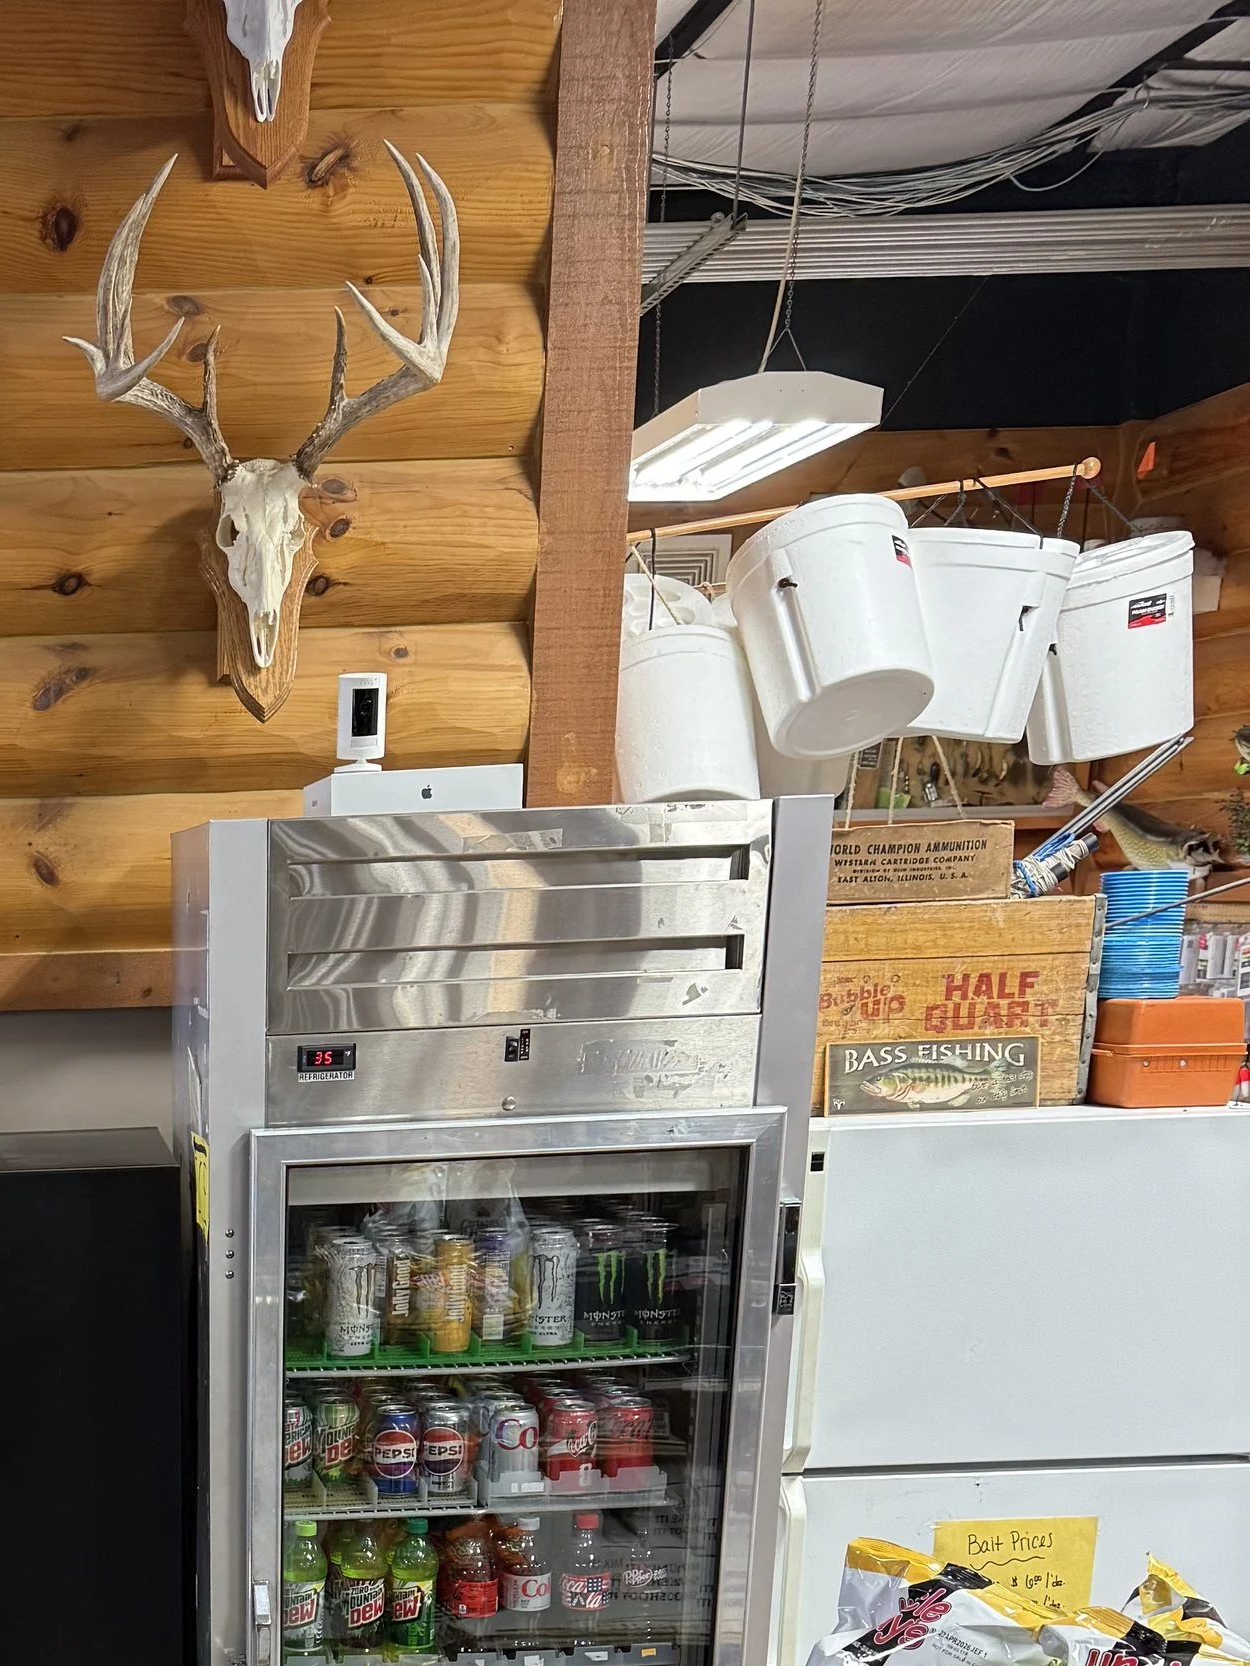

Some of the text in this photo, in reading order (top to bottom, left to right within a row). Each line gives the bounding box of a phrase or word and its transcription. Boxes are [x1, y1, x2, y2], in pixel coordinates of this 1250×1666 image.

[867, 838, 988, 856] CHAMPION AMMUNITION
[834, 854, 977, 867] WESTERN CARTRIDGE COMPANY
[837, 875, 859, 884] EAST
[863, 874, 894, 884] ALTON,
[897, 873, 935, 883] ILLINOIS,
[943, 971, 1040, 1001] HALF
[924, 998, 1059, 1034] QUART
[314, 1051, 333, 1065] 35
[845, 1042, 1026, 1074] BASS FISHING
[299, 1071, 354, 1082] REFRIGERATOR
[967, 1530, 1053, 1556] Bait Prices
